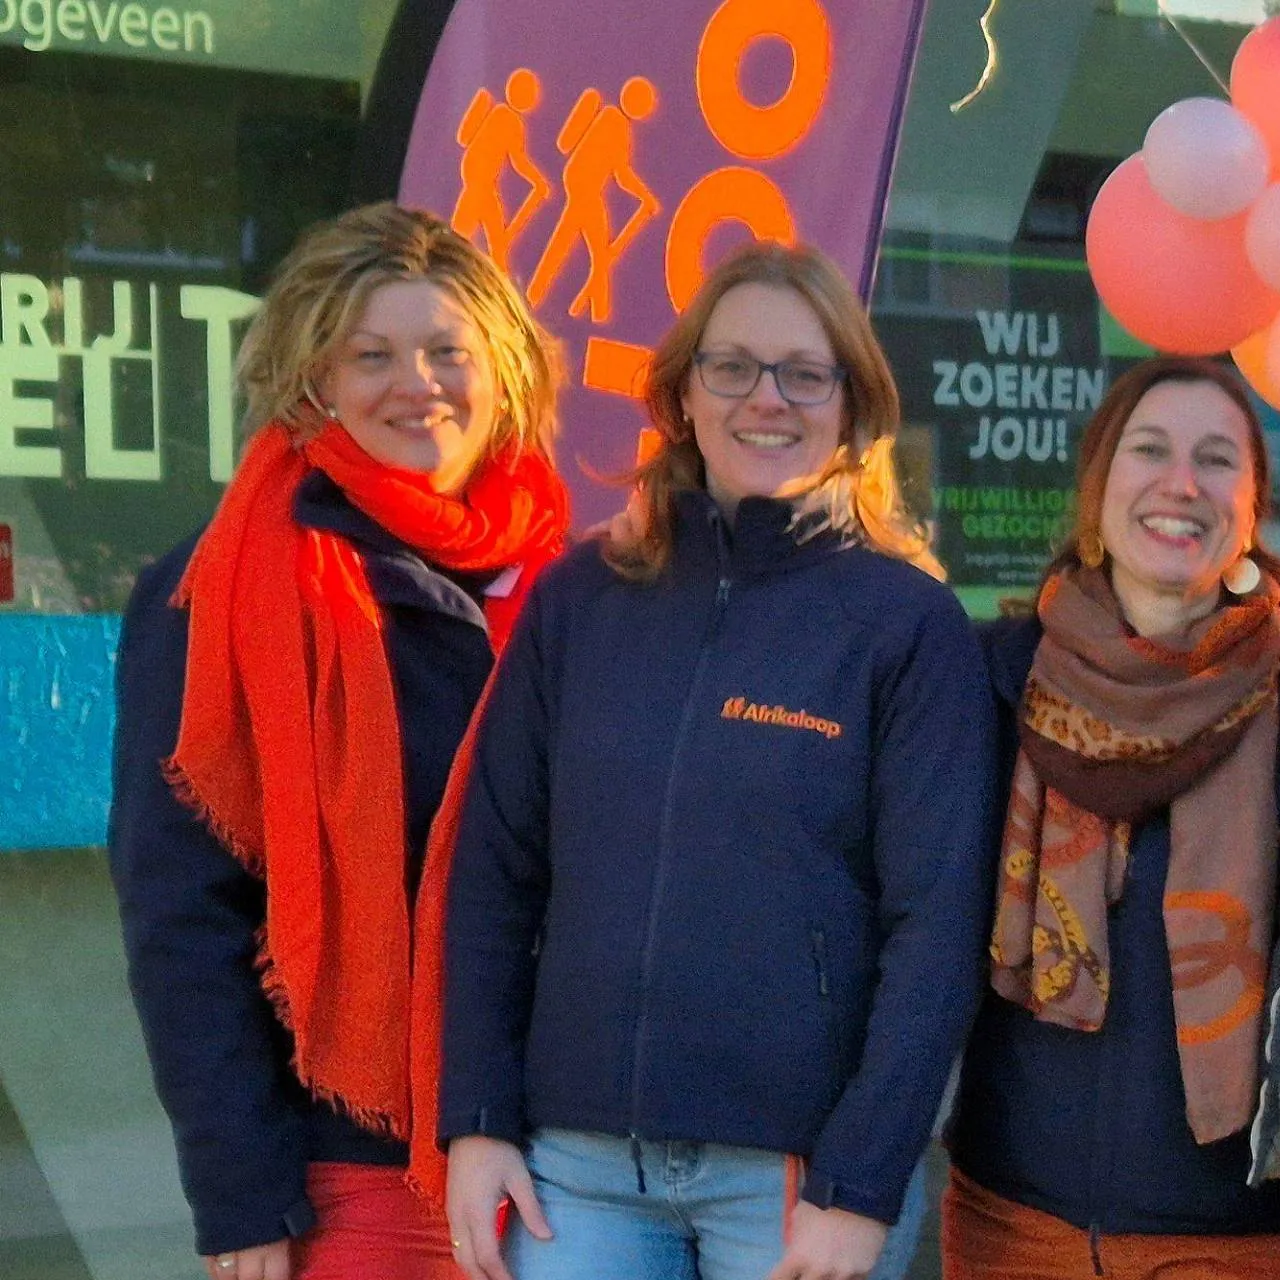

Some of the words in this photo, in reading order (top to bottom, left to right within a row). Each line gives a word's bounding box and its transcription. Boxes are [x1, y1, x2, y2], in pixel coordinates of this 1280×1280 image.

[976, 310, 1060, 358] WIJ
[932, 360, 1104, 411] ZOEKEN
[969, 417, 1069, 463] JOU!
[742, 703, 843, 740] Afrikaloop
